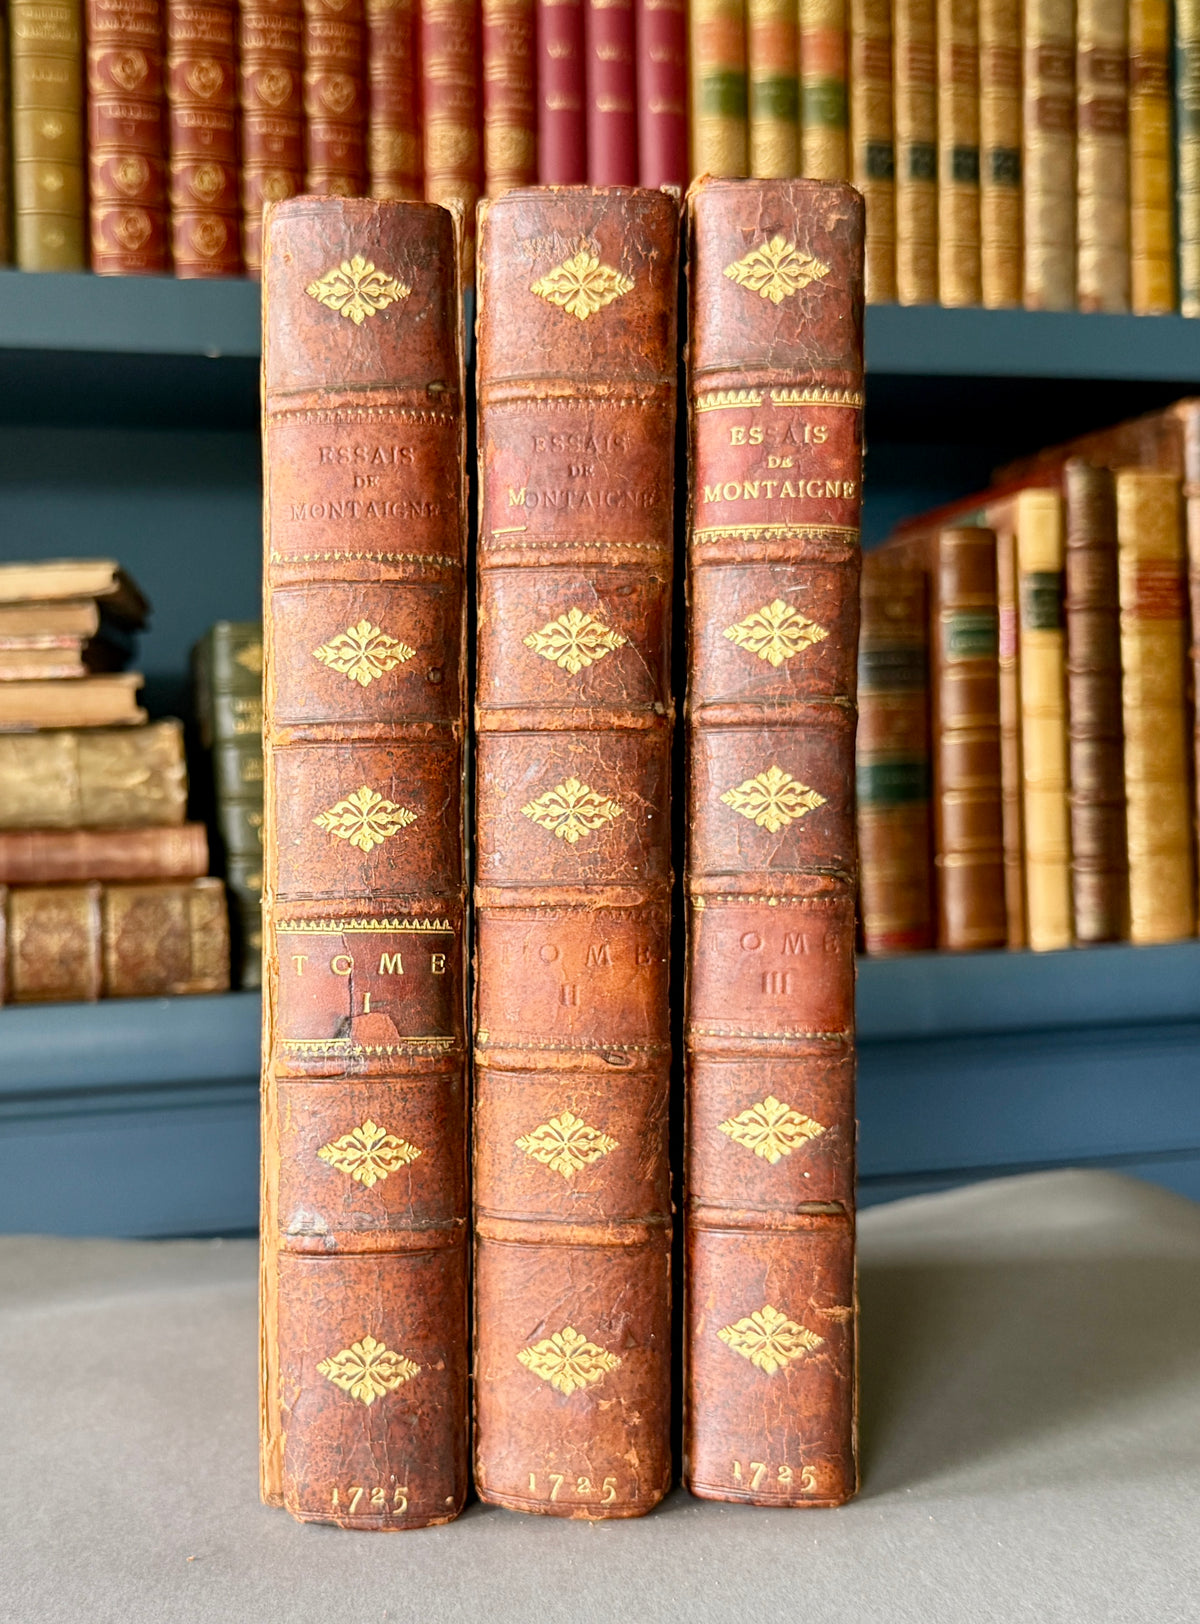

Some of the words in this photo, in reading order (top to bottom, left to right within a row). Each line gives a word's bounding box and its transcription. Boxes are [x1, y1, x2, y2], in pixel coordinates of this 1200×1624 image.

[532, 433, 631, 454] ESSAIS
[729, 423, 829, 446] ESSAIS
[318, 446, 415, 465] ESSAIS
[767, 455, 794, 469] DE
[353, 474, 380, 489] DE
[567, 463, 595, 478] DE
[507, 485, 655, 509] MONTAIGNE
[702, 479, 857, 503] MONTAIGNE
[289, 499, 441, 521] MONTAIGNE
[291, 952, 447, 976] TOME
[760, 969, 793, 995] III
[362, 992, 371, 1014] I
[559, 983, 579, 1007] II
[732, 1460, 817, 1493] 1725
[528, 1472, 617, 1505] 1725
[330, 1486, 409, 1516] 1725
